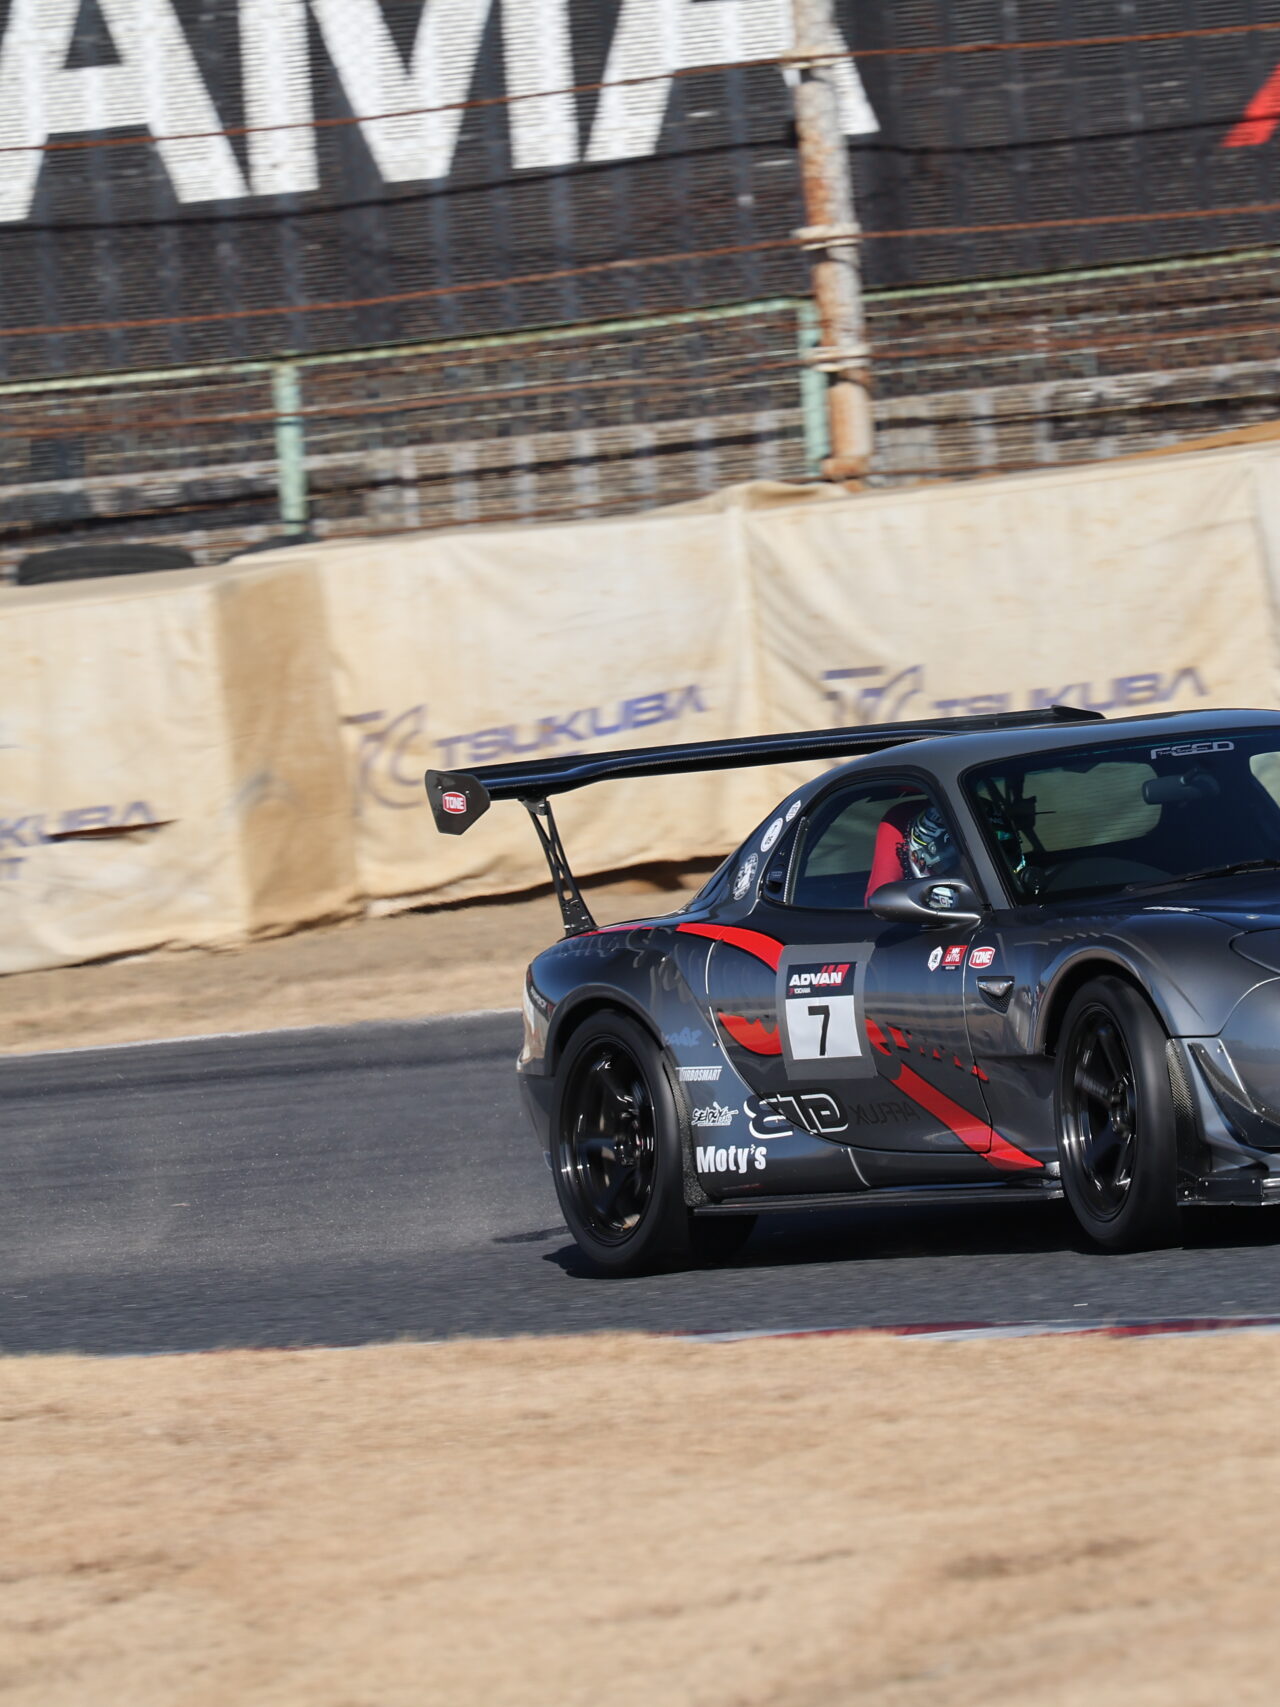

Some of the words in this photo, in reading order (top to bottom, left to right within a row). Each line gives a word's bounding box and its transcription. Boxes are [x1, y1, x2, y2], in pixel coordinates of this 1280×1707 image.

[433, 684, 706, 768] TSUKUBA
[443, 795, 466, 810] TONE
[971, 949, 994, 965] TONE
[789, 972, 842, 986] ADVAN
[808, 1005, 830, 1056] 7
[675, 1066, 722, 1081] TURBOSMART
[696, 1144, 767, 1174] Moty's
